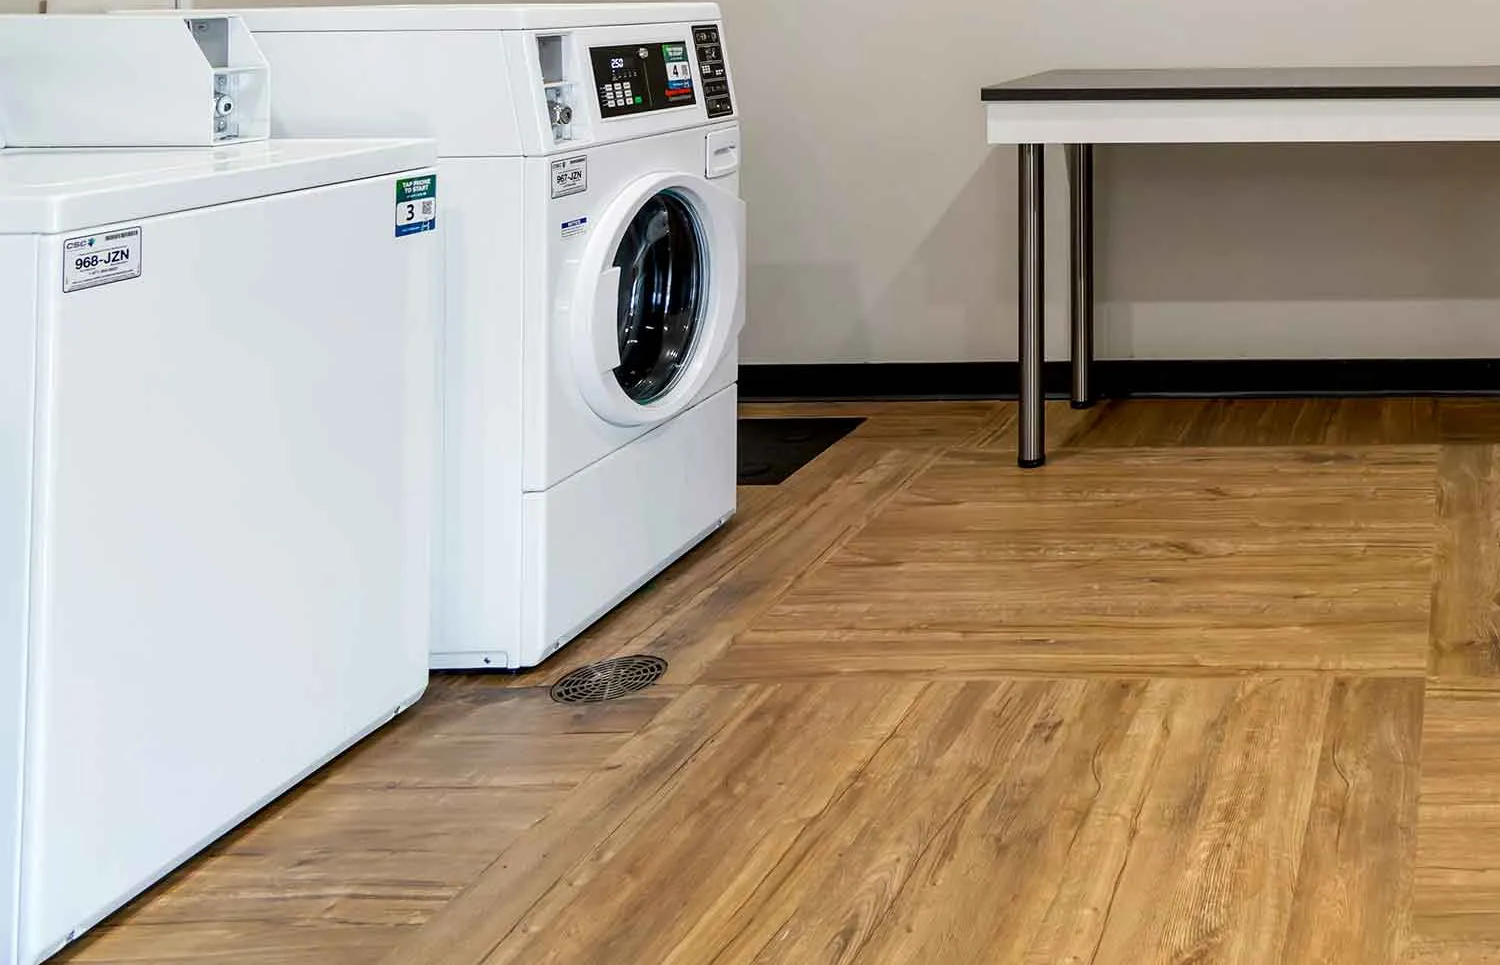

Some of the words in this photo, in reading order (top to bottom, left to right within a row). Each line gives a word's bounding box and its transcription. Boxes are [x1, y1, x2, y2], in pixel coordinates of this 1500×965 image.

[672, 64, 679, 77] 4
[556, 170, 582, 184] 967-JZN
[406, 203, 415, 221] 3
[66, 239, 87, 250] CSC
[75, 248, 130, 270] 968-JZN
